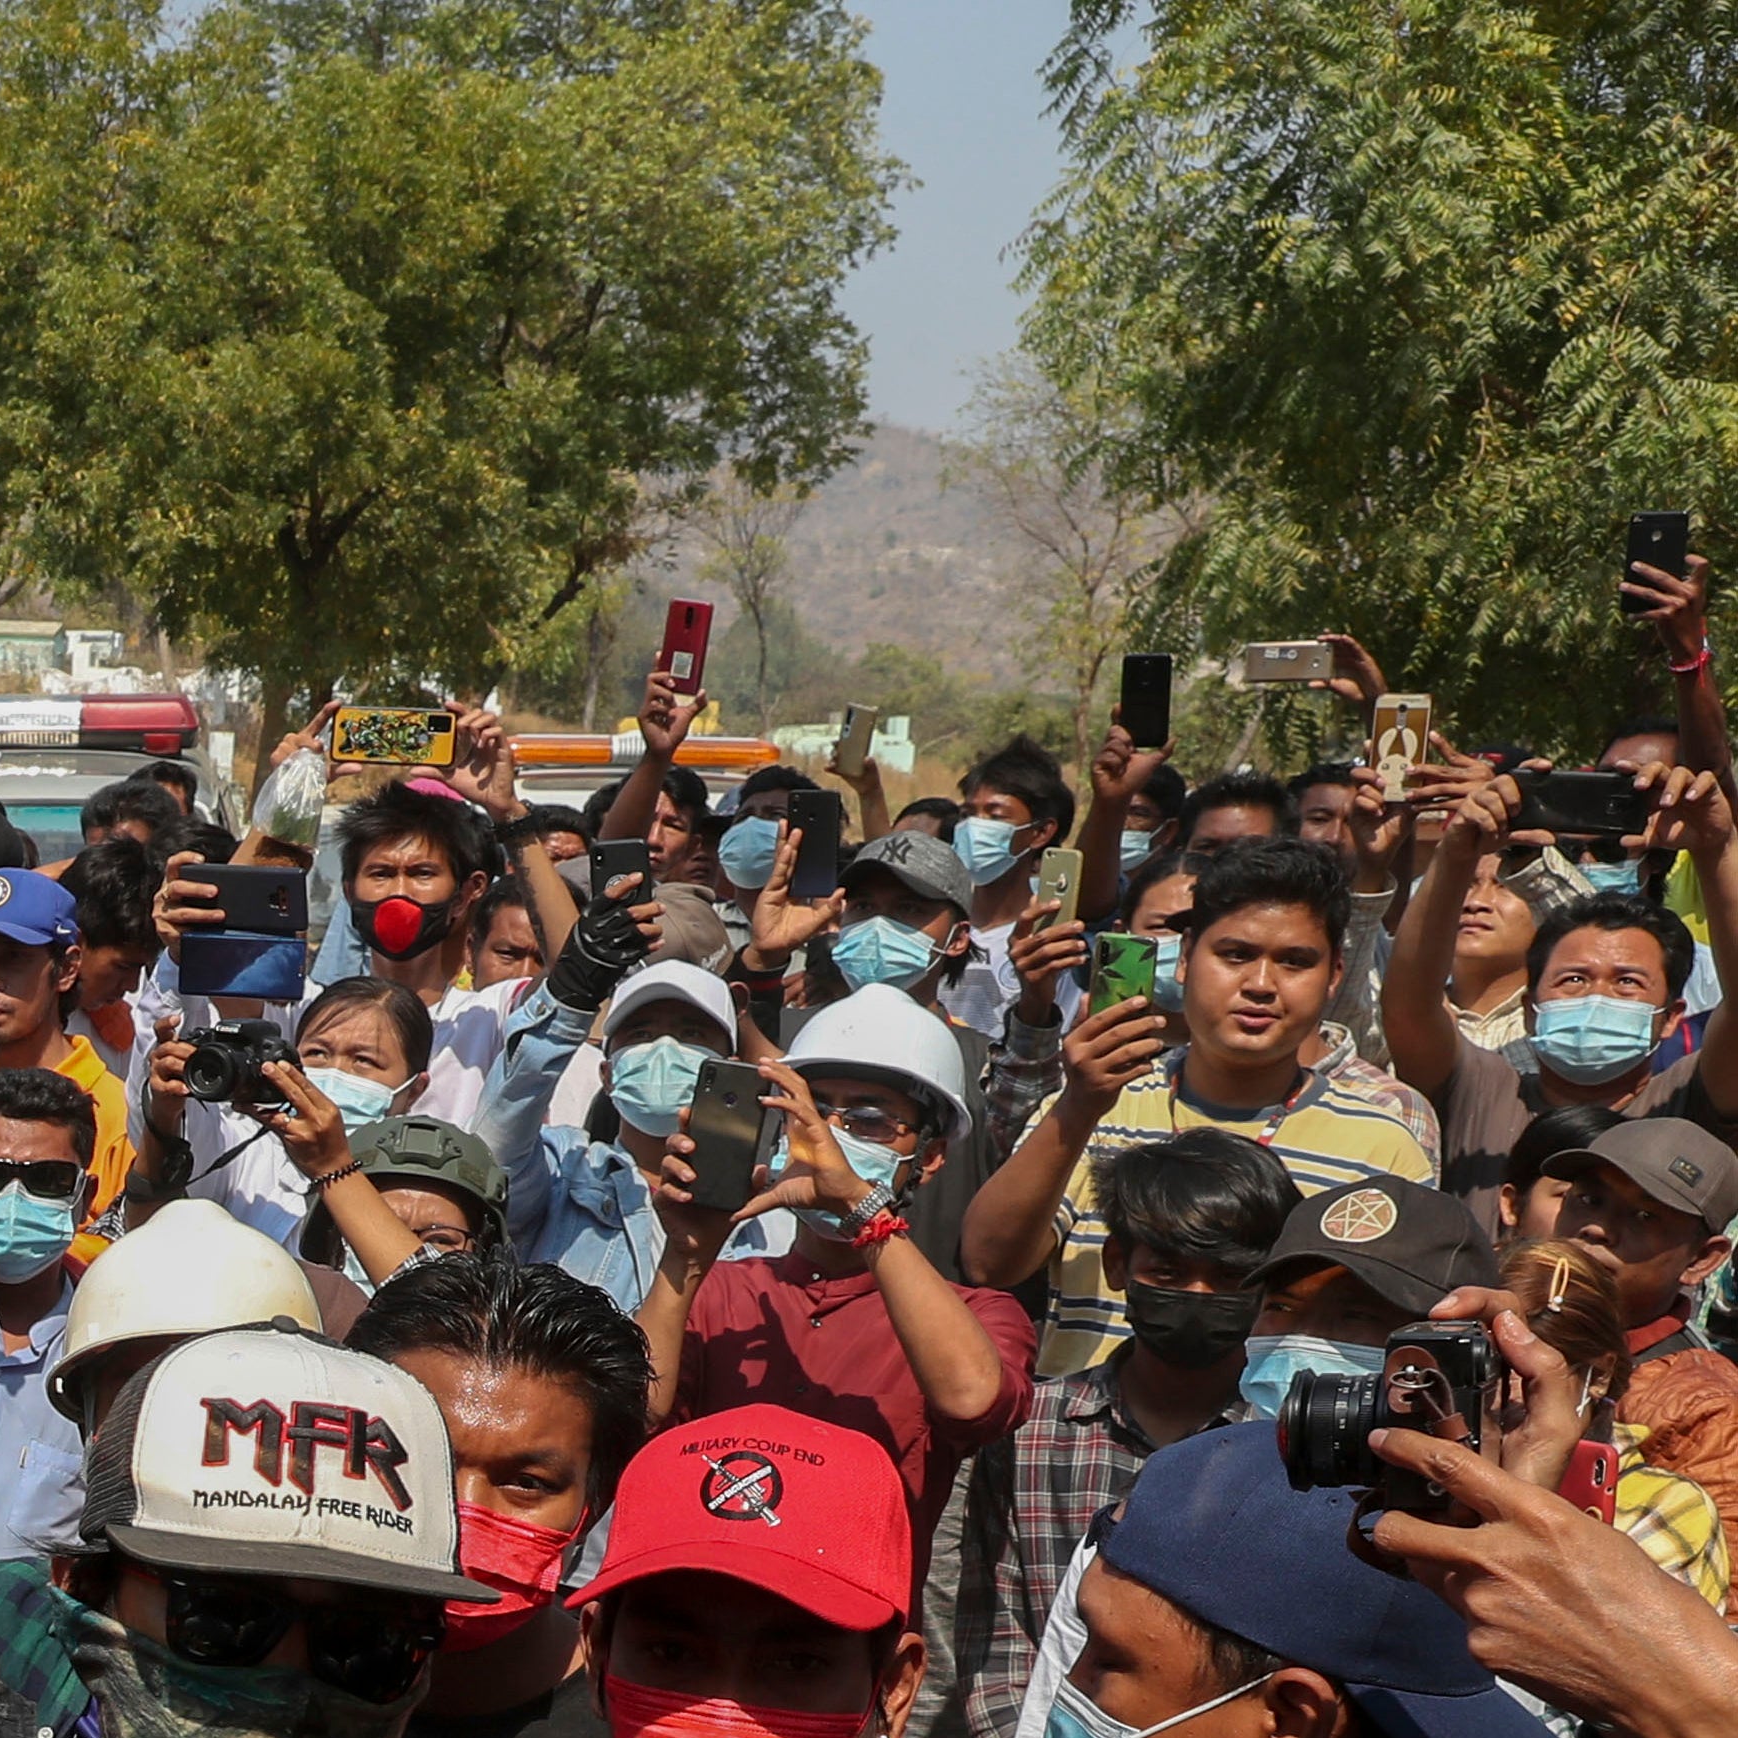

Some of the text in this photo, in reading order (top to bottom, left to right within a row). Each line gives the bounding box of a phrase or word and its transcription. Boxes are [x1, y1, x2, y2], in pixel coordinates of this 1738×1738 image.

[200, 1397, 413, 1512] MFR
[679, 1437, 825, 1467] MILITARY COUP END
[193, 1490, 414, 1536] MANDALAY FREE RIDER
